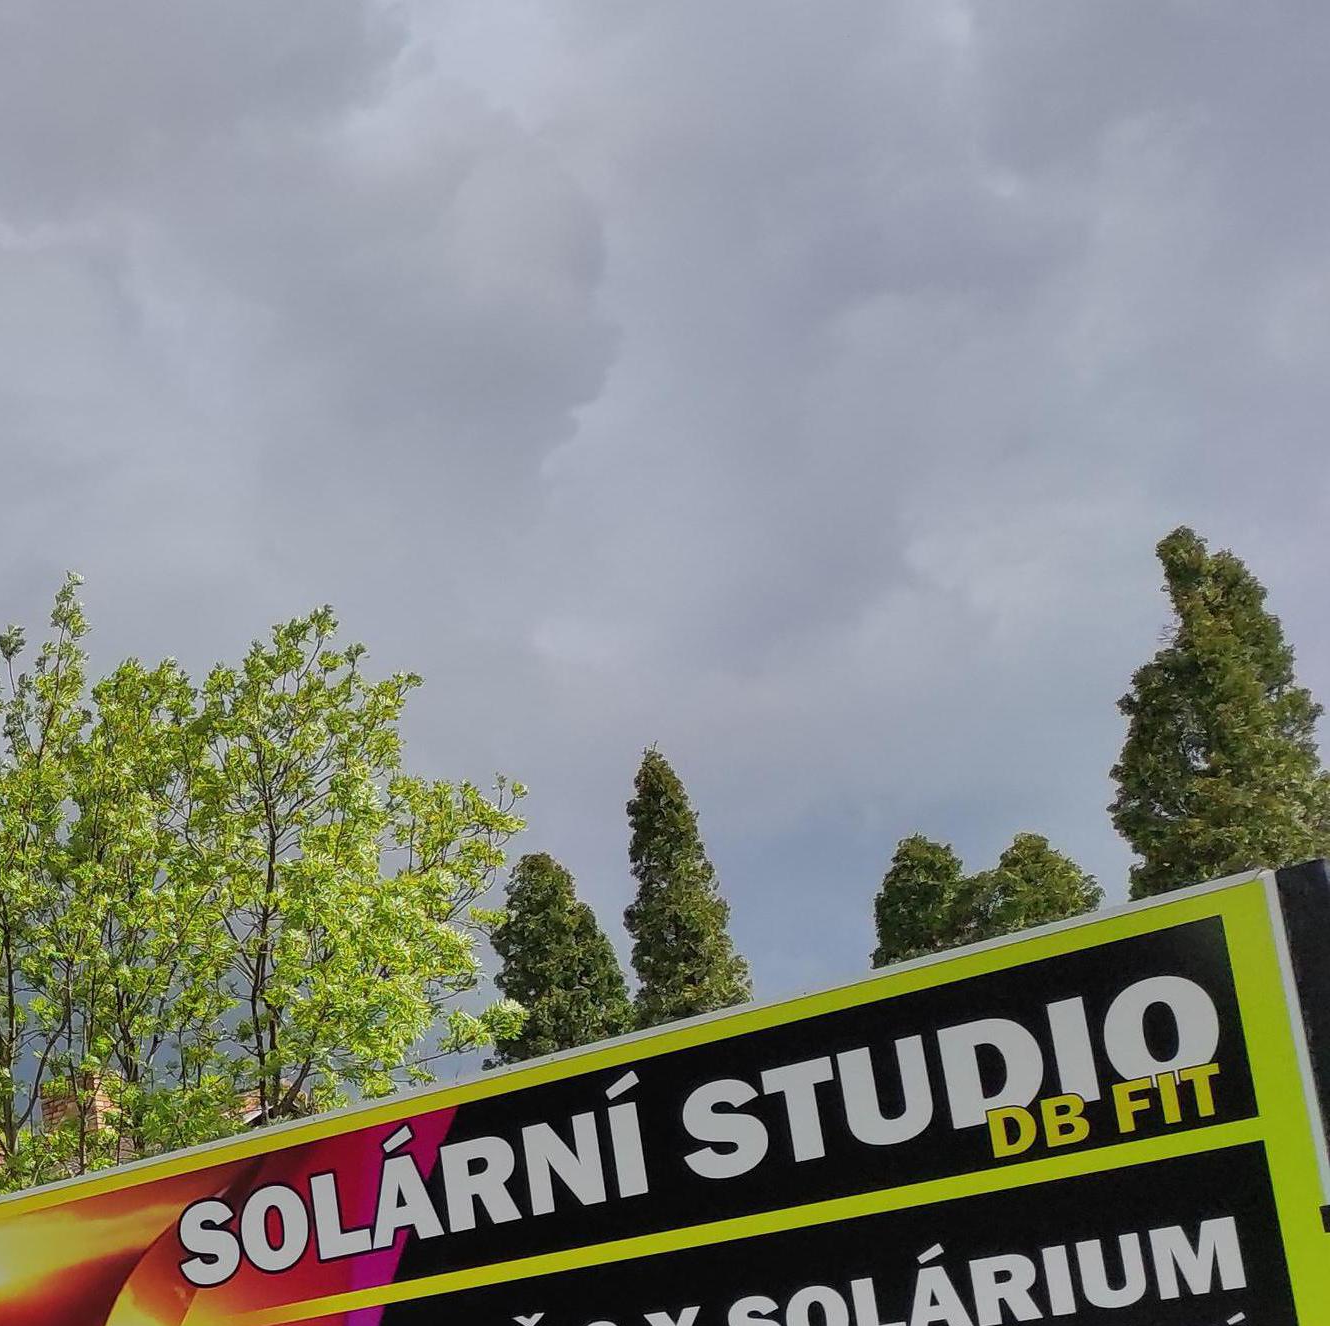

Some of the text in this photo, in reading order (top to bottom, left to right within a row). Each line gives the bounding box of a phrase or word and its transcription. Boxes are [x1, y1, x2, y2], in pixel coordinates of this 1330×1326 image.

[177, 973, 1223, 1289] SOLÁRNÍ STUDIO
[986, 1063, 1222, 1160] DB FIT
